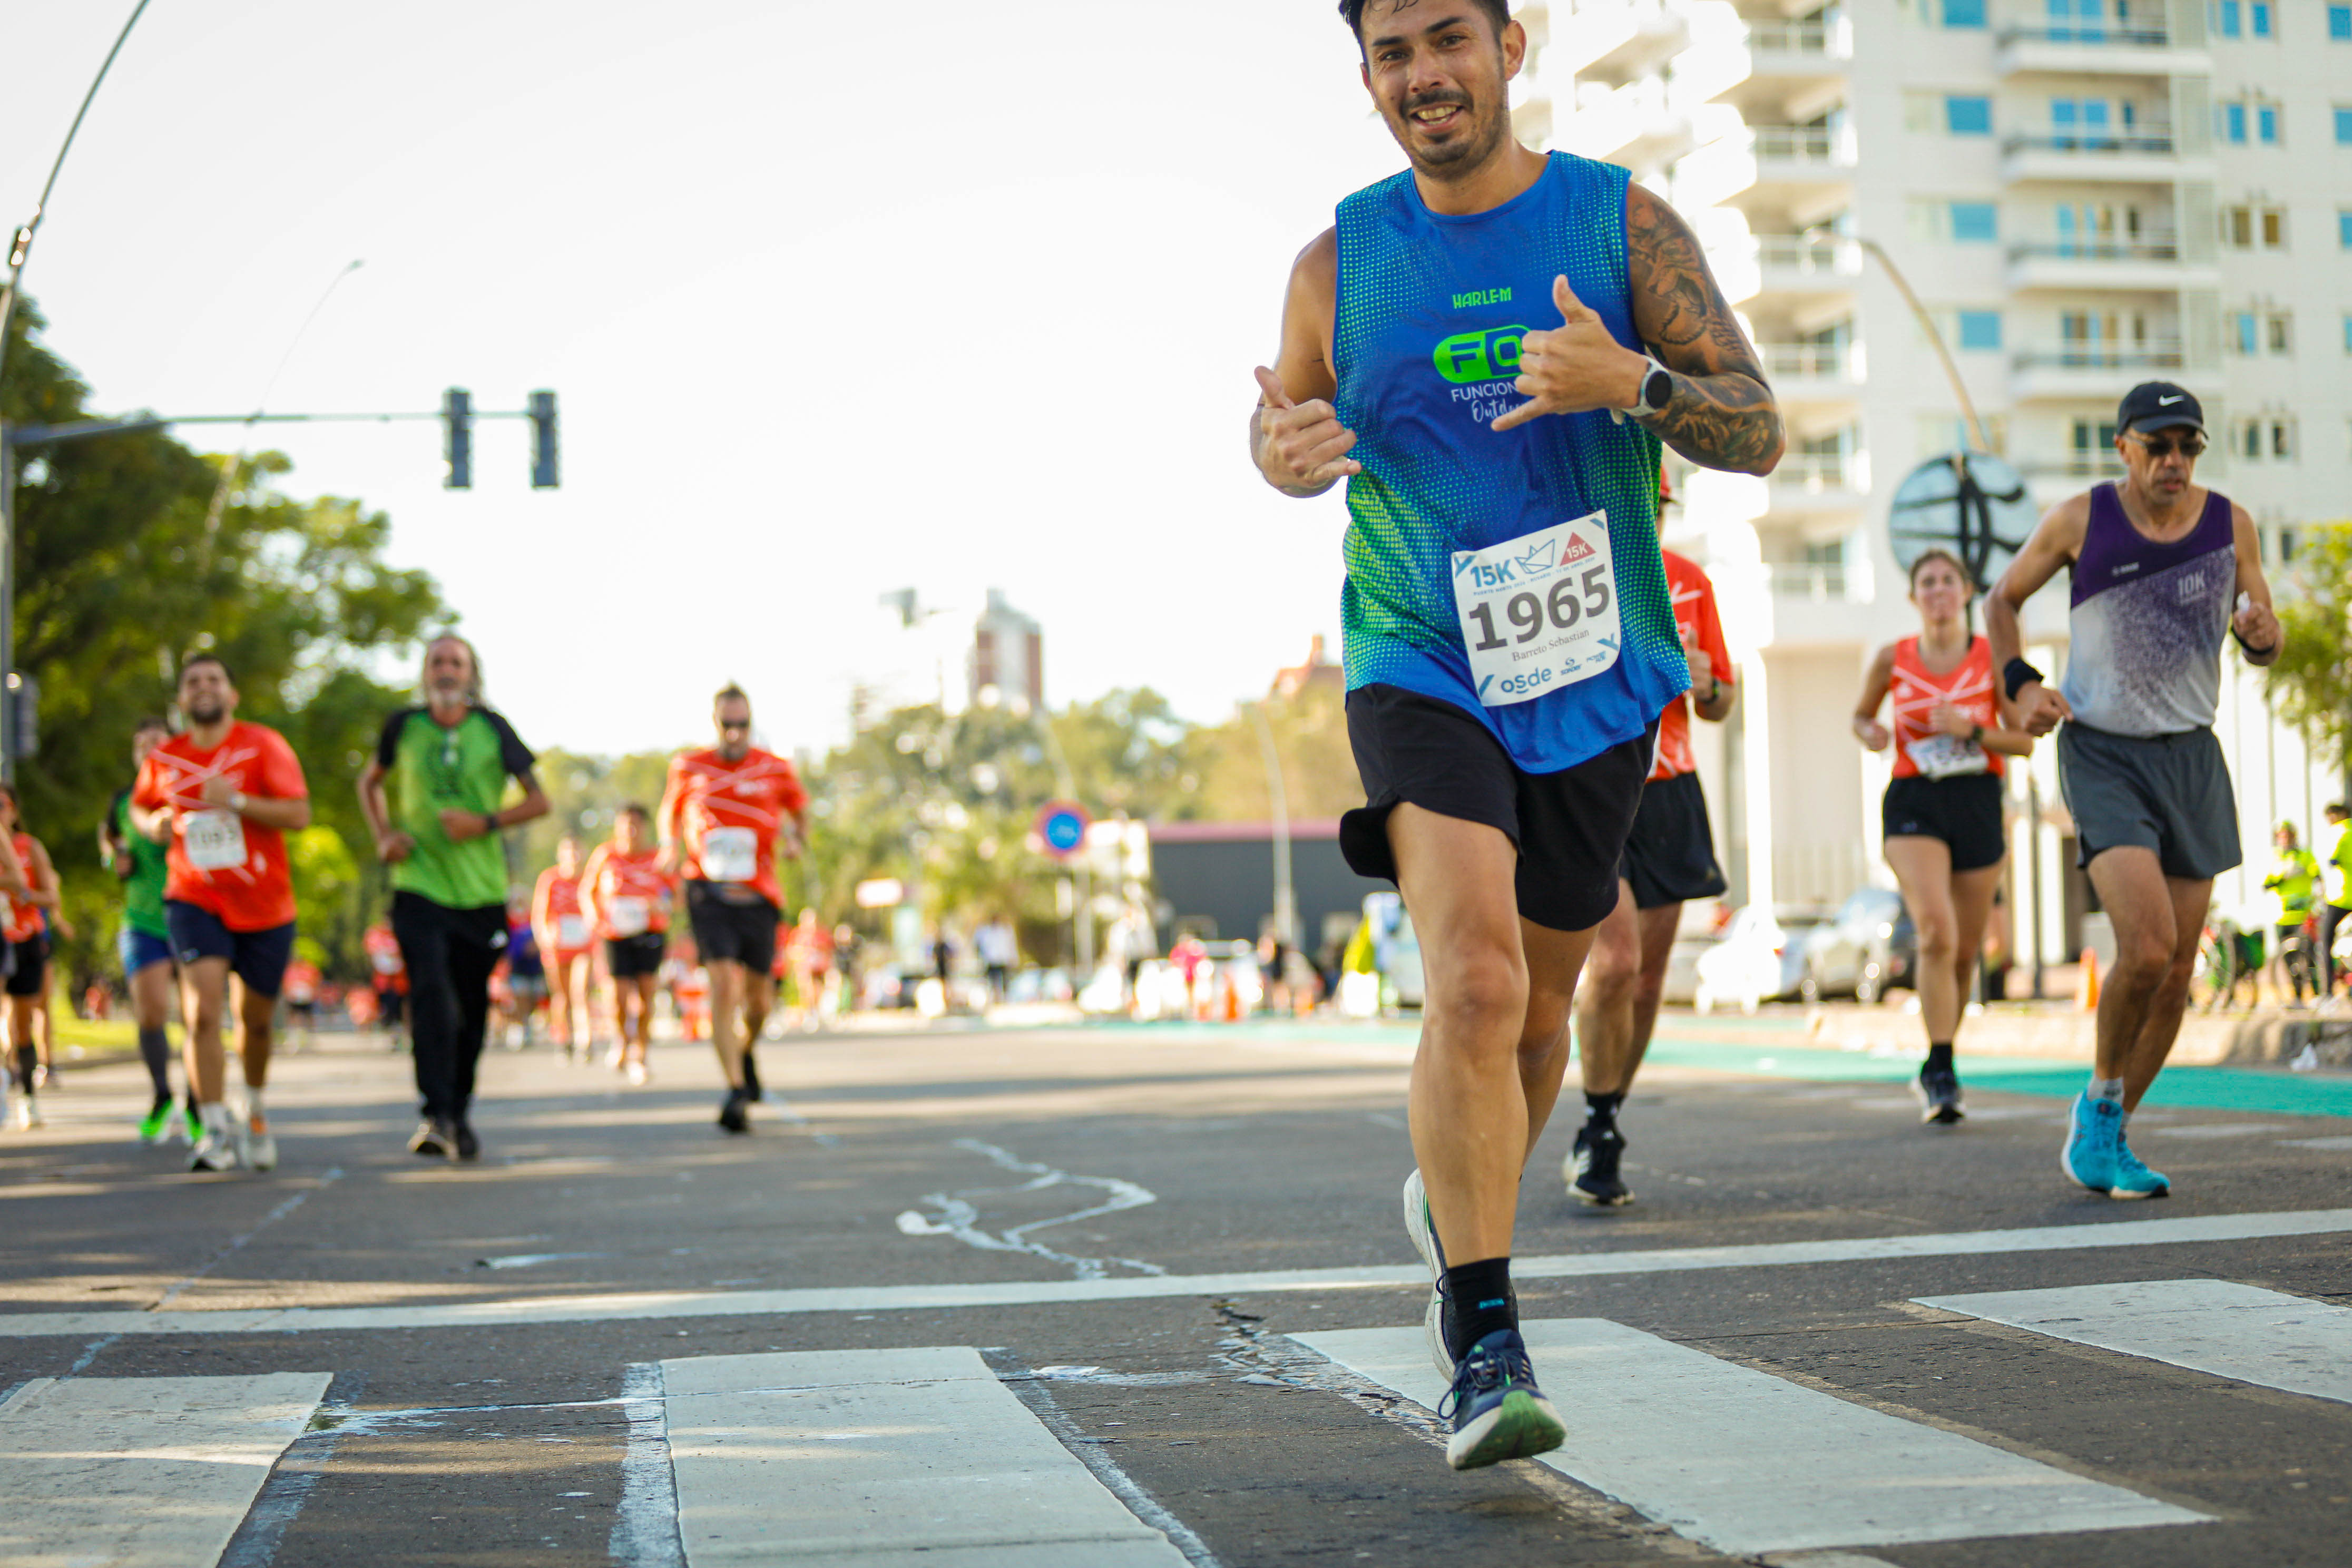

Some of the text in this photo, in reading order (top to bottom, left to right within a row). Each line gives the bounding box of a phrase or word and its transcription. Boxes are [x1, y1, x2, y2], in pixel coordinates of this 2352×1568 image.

[1452, 287, 1512, 309] HARLEM
[1566, 543, 1588, 559] 15K
[1470, 559, 1516, 587] 15K
[2178, 569, 2206, 596] 10K
[1469, 563, 1610, 651] 1965
[1512, 629, 1590, 662] Barreto Sebastian
[1501, 667, 1552, 694] osde
